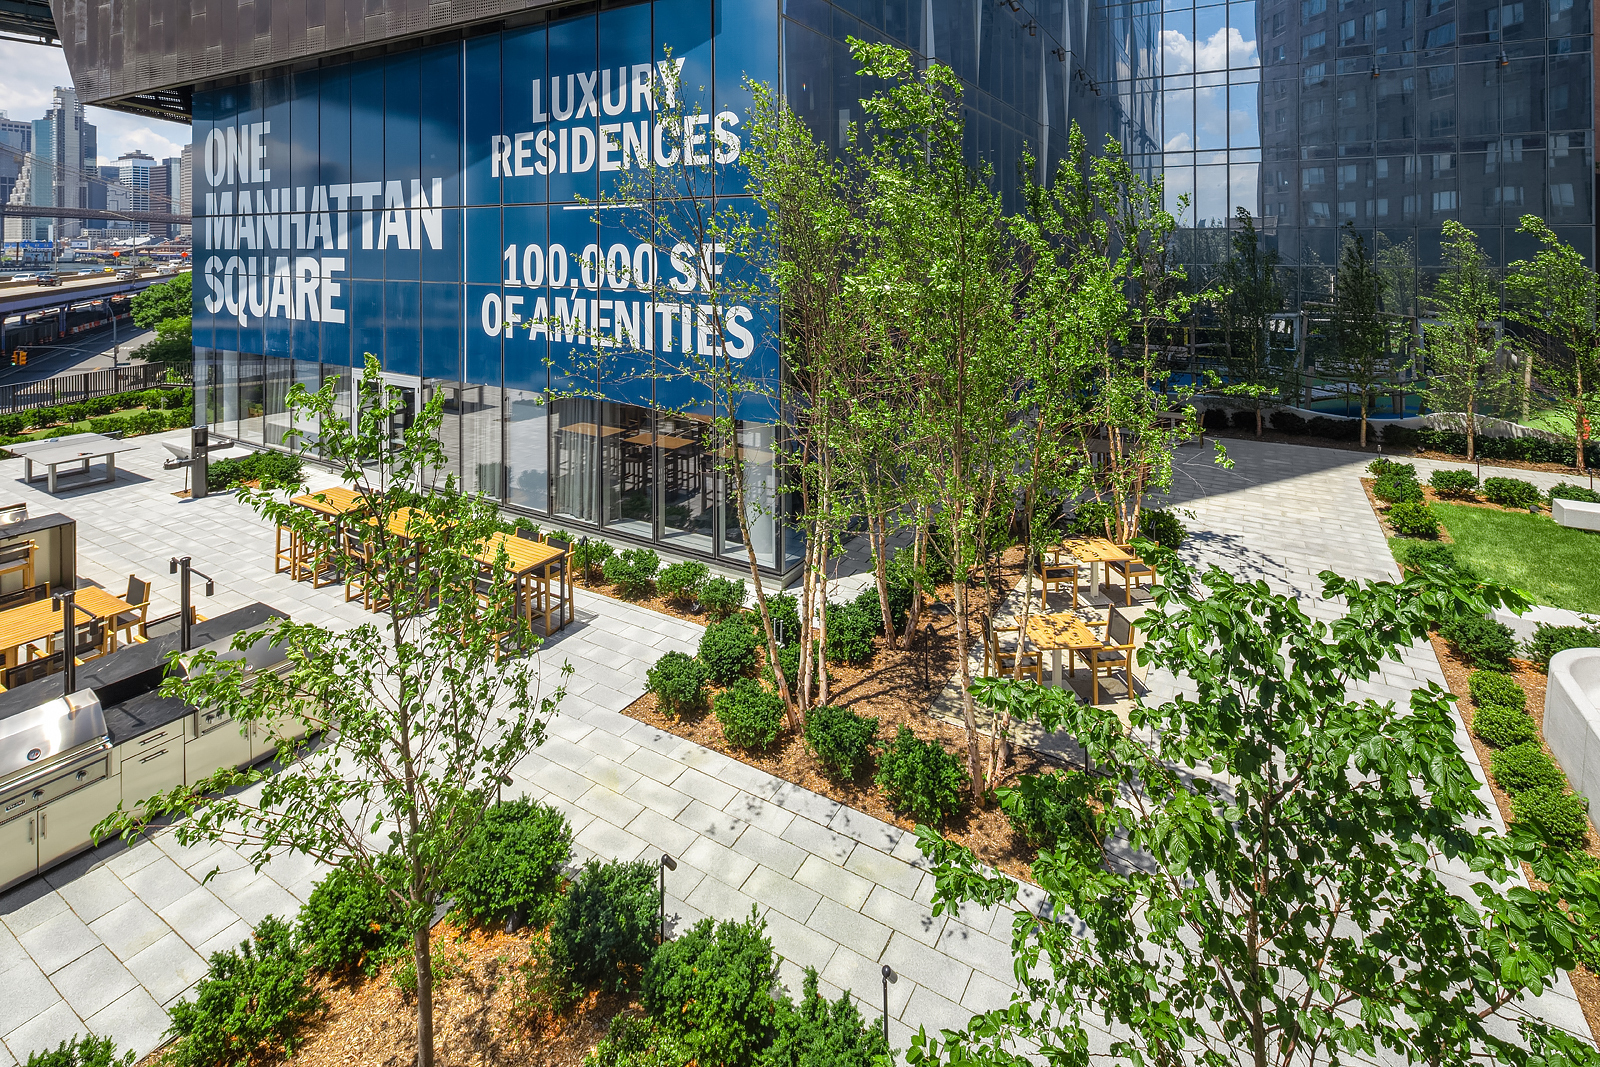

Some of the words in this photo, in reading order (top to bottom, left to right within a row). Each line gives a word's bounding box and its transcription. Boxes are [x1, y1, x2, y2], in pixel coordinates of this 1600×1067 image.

[532, 57, 685, 123] LUXURY
[204, 122, 269, 186] ONE
[491, 111, 740, 178] RESIDENCES
[205, 178, 443, 250] MANHATTAN
[204, 256, 345, 328] SQUARE
[504, 243, 657, 300] 100,000
[670, 243, 726, 296] SF
[481, 293, 525, 339] OF
[529, 297, 755, 359] AMENITIES
